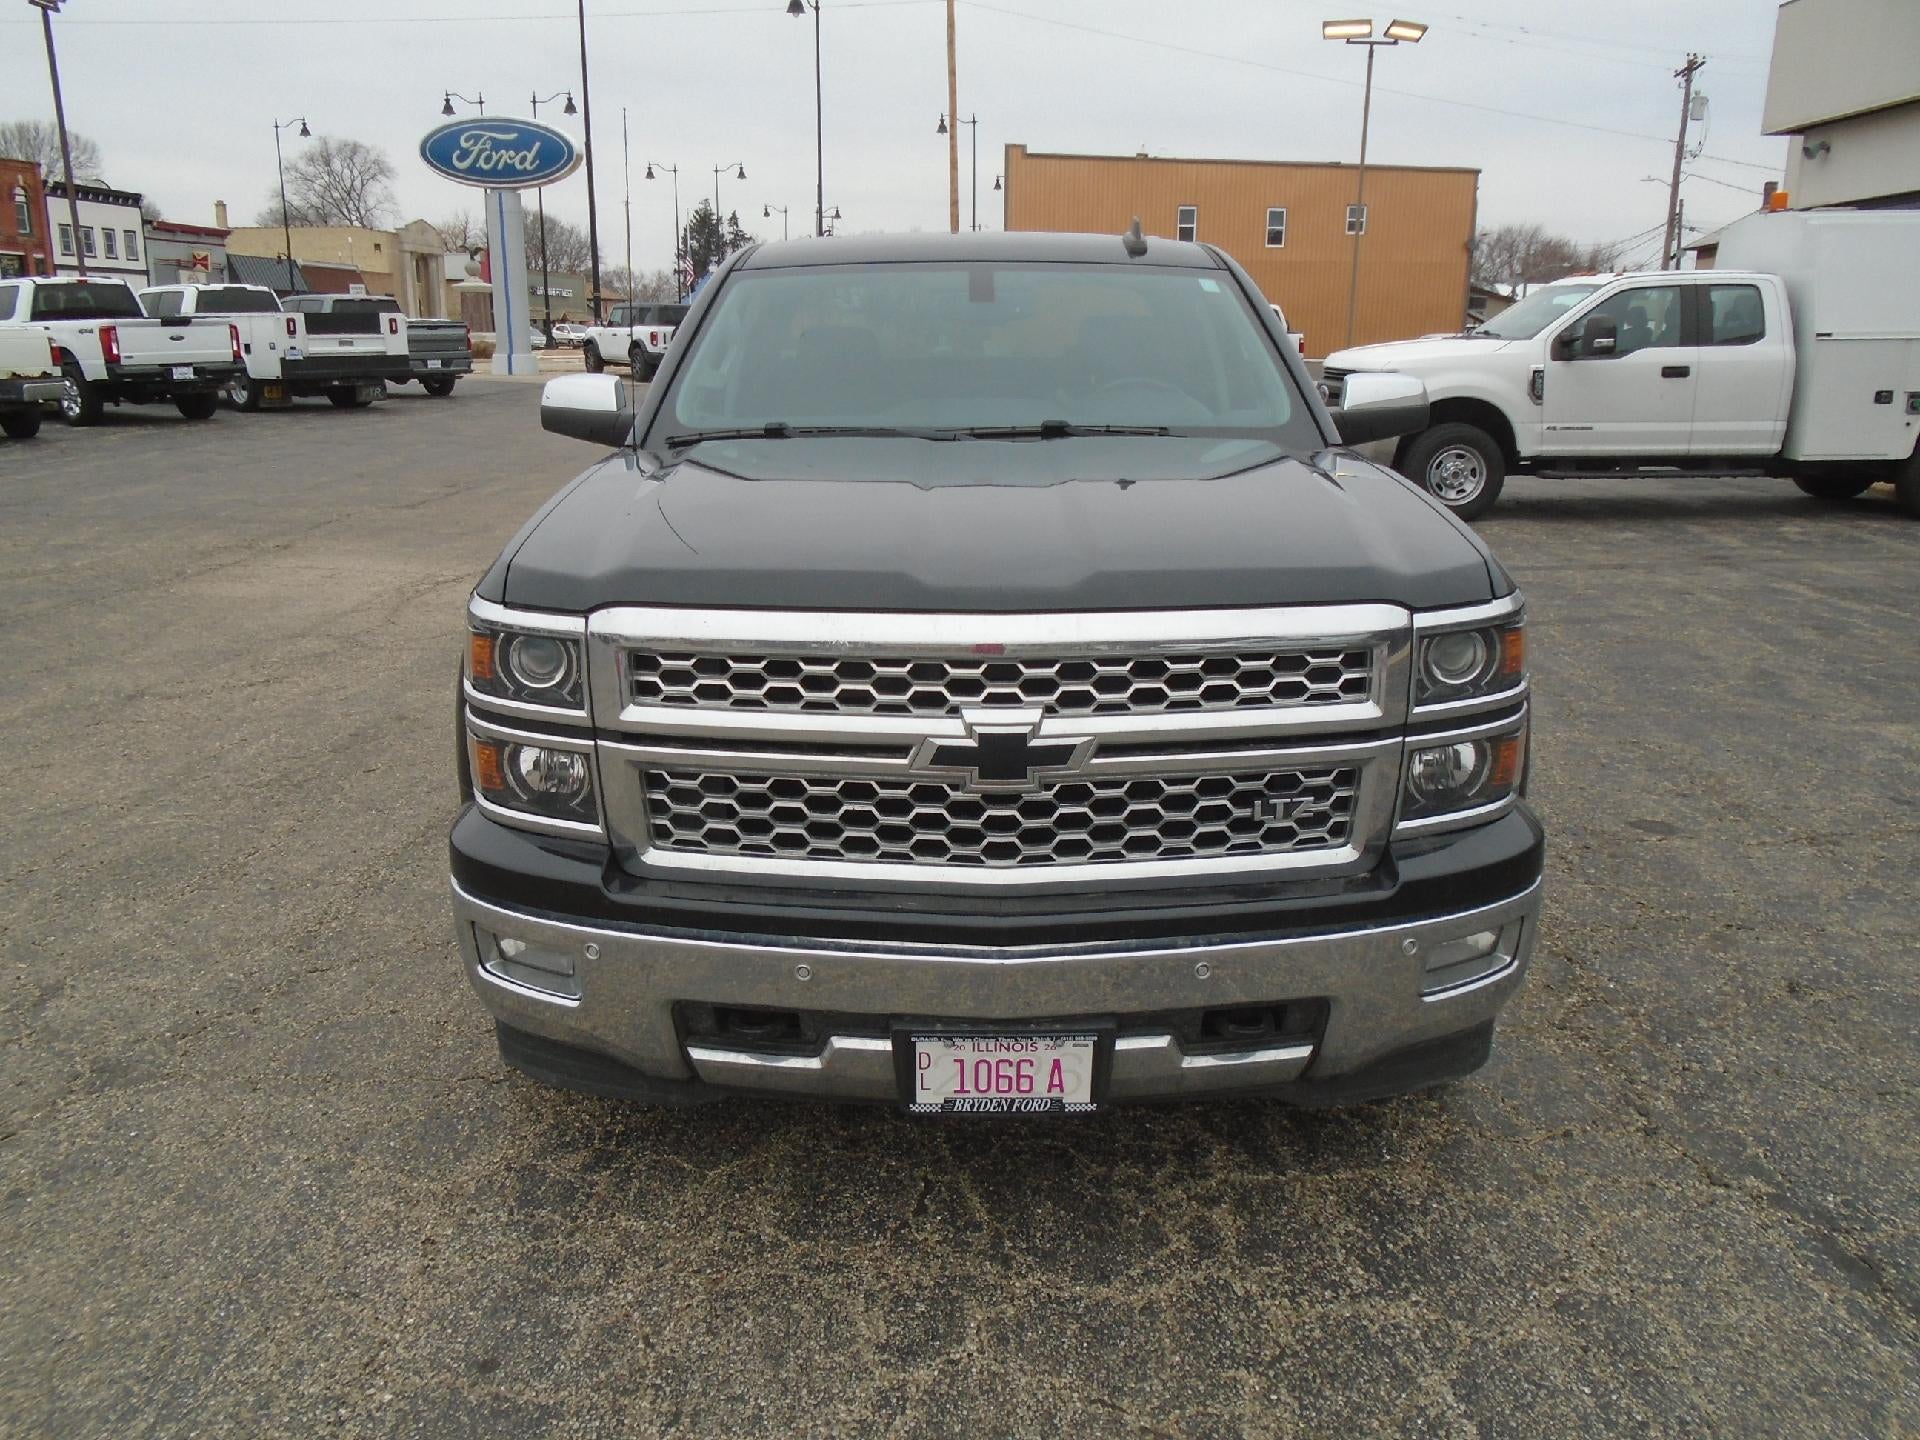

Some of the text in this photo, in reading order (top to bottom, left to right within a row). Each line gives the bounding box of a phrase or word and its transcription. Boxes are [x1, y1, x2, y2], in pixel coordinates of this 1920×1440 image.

[452, 130, 541, 170] Ford
[1253, 796, 1315, 821] LTZ
[972, 1041, 1039, 1052] ILLINOIS
[953, 1058, 1065, 1094] 1066 A
[952, 1098, 1052, 1112] BRYDEN FORD
